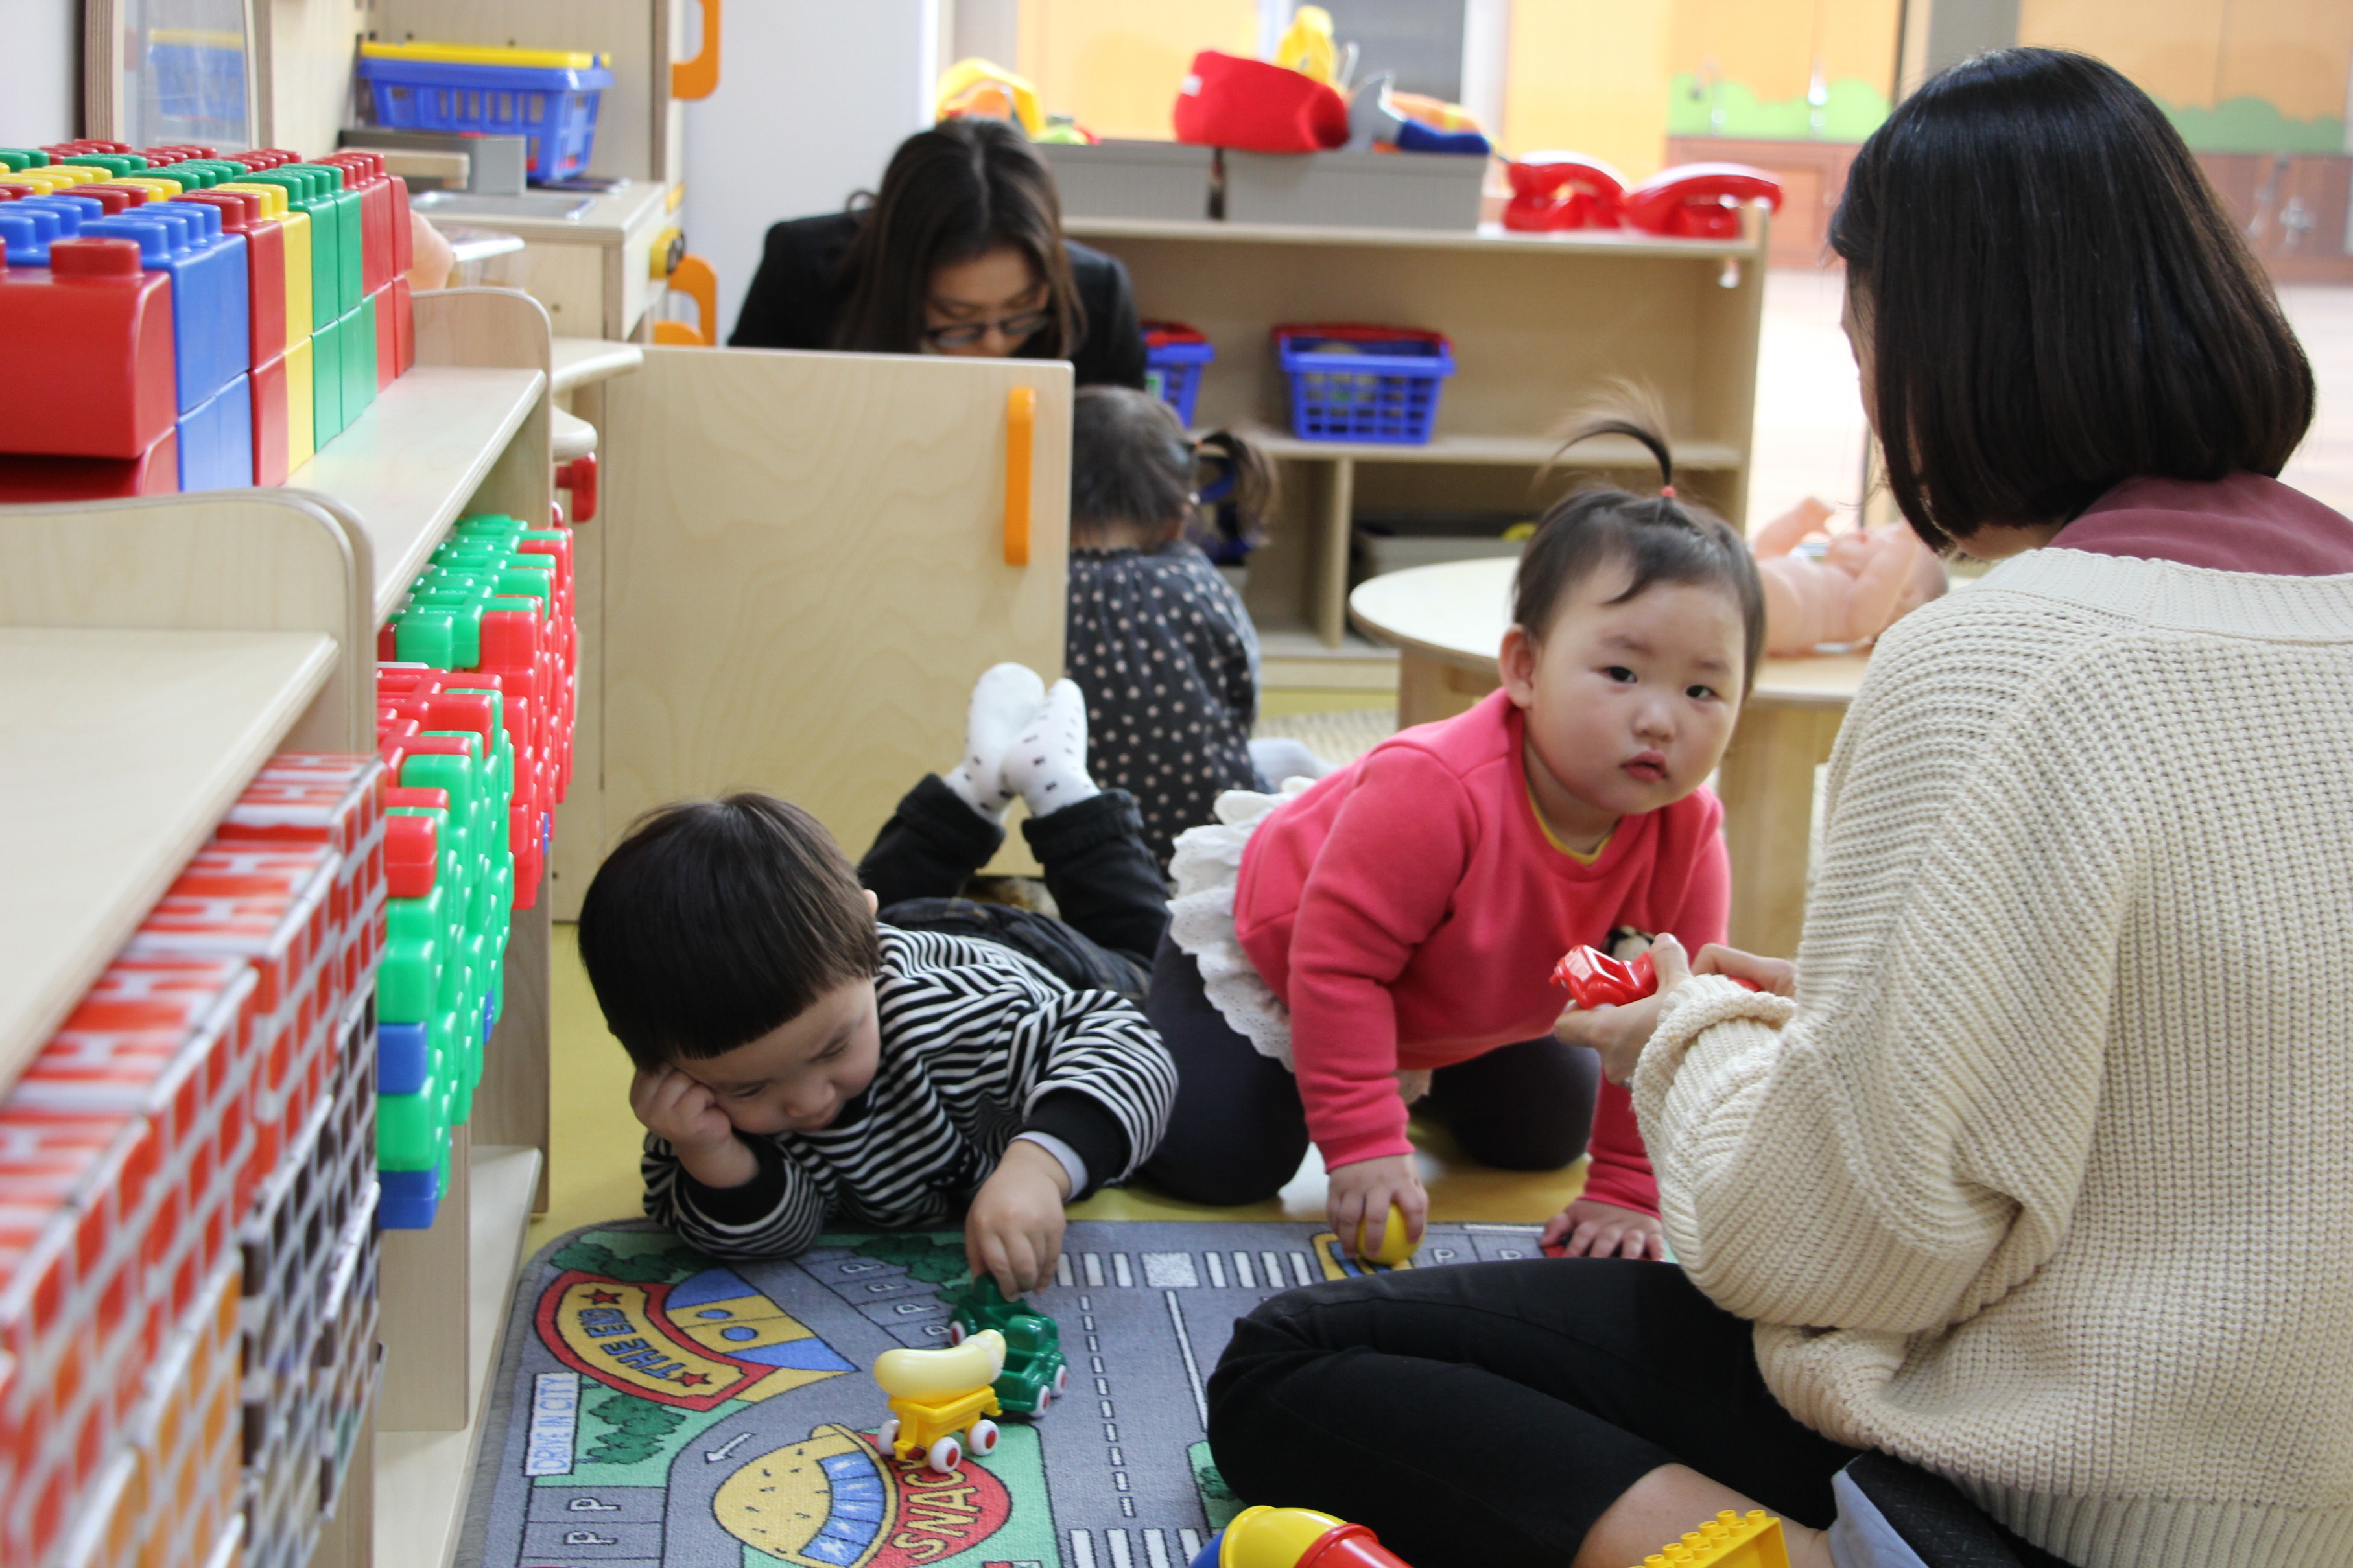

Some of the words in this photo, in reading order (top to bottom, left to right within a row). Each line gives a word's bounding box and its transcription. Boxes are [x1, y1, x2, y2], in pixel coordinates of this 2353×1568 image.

[600, 1337, 687, 1379] THE
[538, 1377, 574, 1411] CITY
[537, 1415, 573, 1427] IN
[531, 1431, 571, 1470] DRIVE
[566, 1497, 621, 1512] P
[563, 1530, 618, 1545] P
